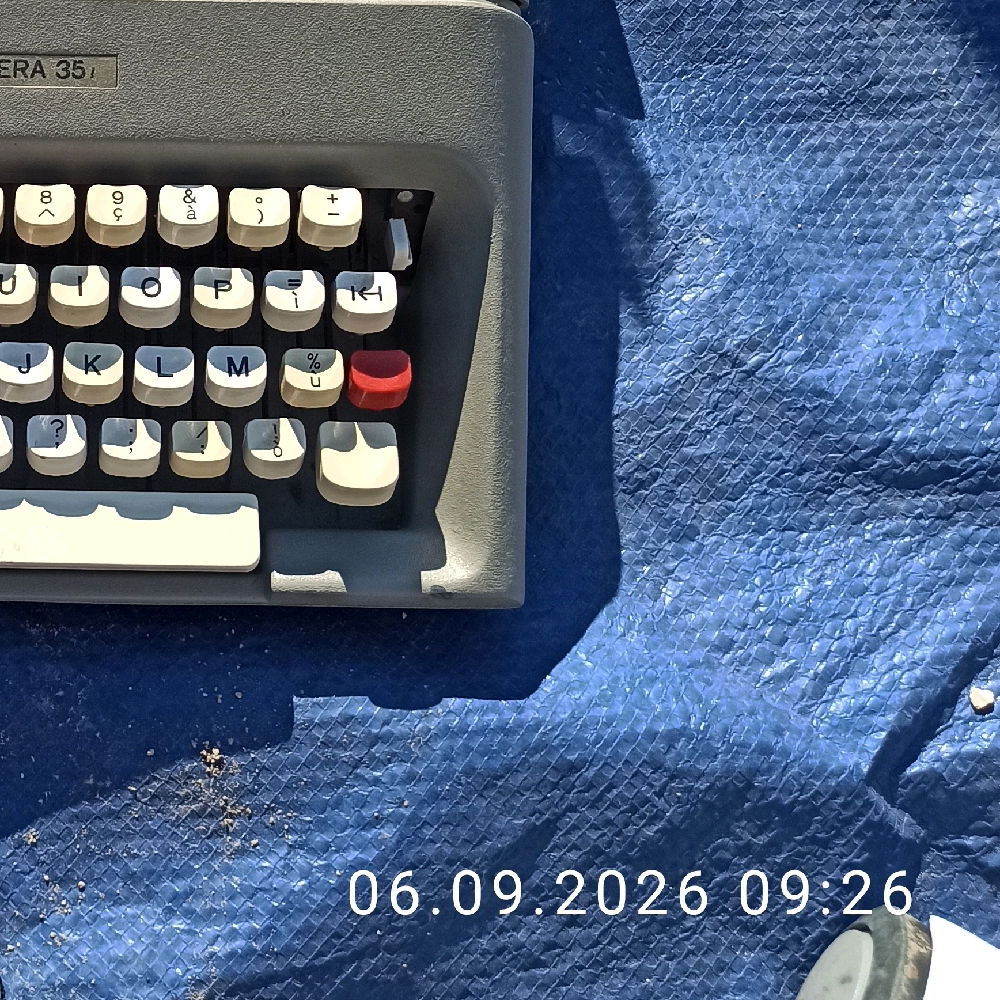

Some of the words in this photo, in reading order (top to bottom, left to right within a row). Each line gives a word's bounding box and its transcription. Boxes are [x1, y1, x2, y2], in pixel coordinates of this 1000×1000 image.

[40, 190, 52, 204] 8
[112, 190, 124, 205] 9
[186, 205, 197, 220] à
[141, 276, 162, 298] O
[213, 278, 233, 300] P
[18, 353, 32, 375] J
[84, 353, 103, 376] K
[156, 356, 174, 378] L
[226, 355, 250, 378] M
[50, 417, 64, 438] ?
